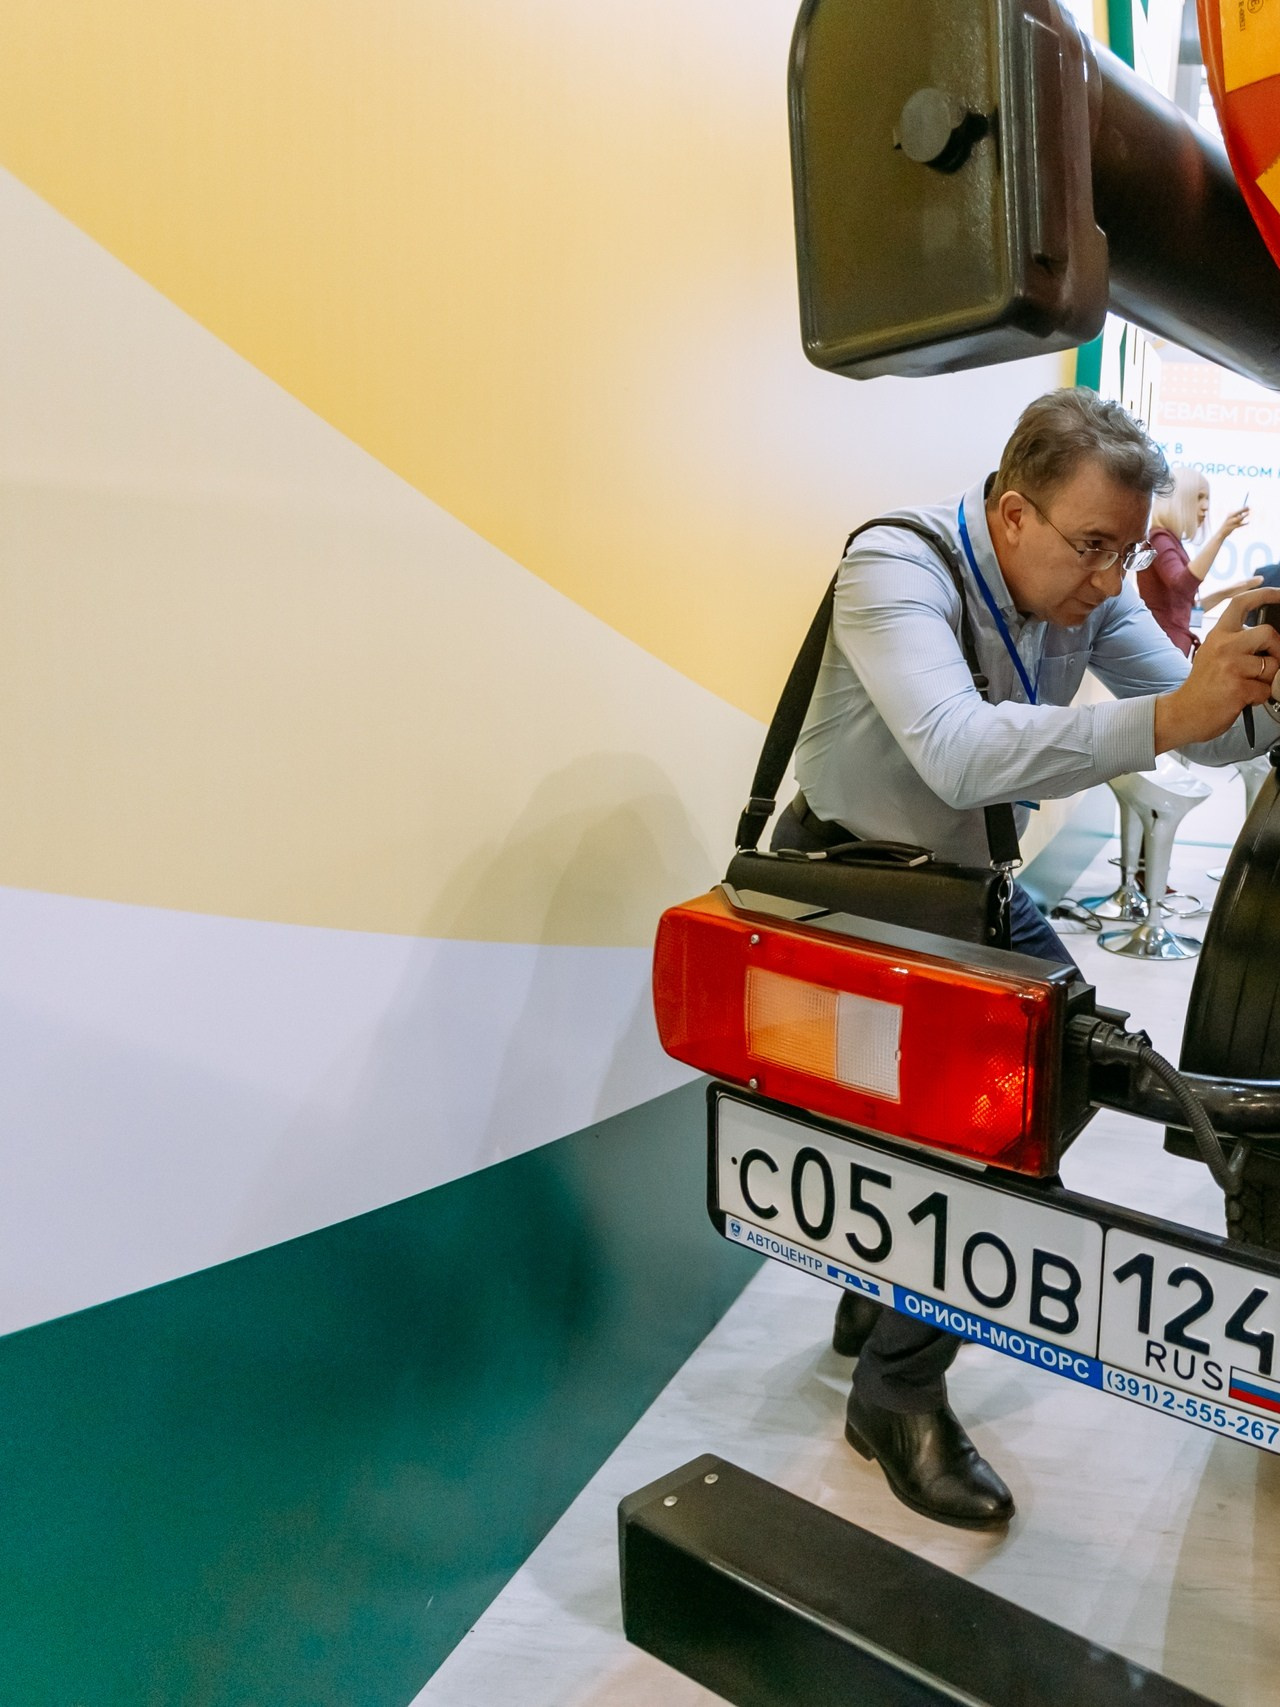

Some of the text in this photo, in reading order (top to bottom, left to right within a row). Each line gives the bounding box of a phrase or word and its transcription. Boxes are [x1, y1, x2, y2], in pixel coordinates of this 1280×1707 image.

[1153, 401, 1239, 424] РЕВАЕМ
[1175, 442, 1184, 454] В
[1170, 460, 1272, 479] СНОЯРСКОМ
[746, 1230, 824, 1271] АВТОЦЕНТР
[904, 1294, 1091, 1380] ОРИОН-МОТОРС
[1112, 1252, 1275, 1376] 124
[1145, 1340, 1224, 1391] RUS
